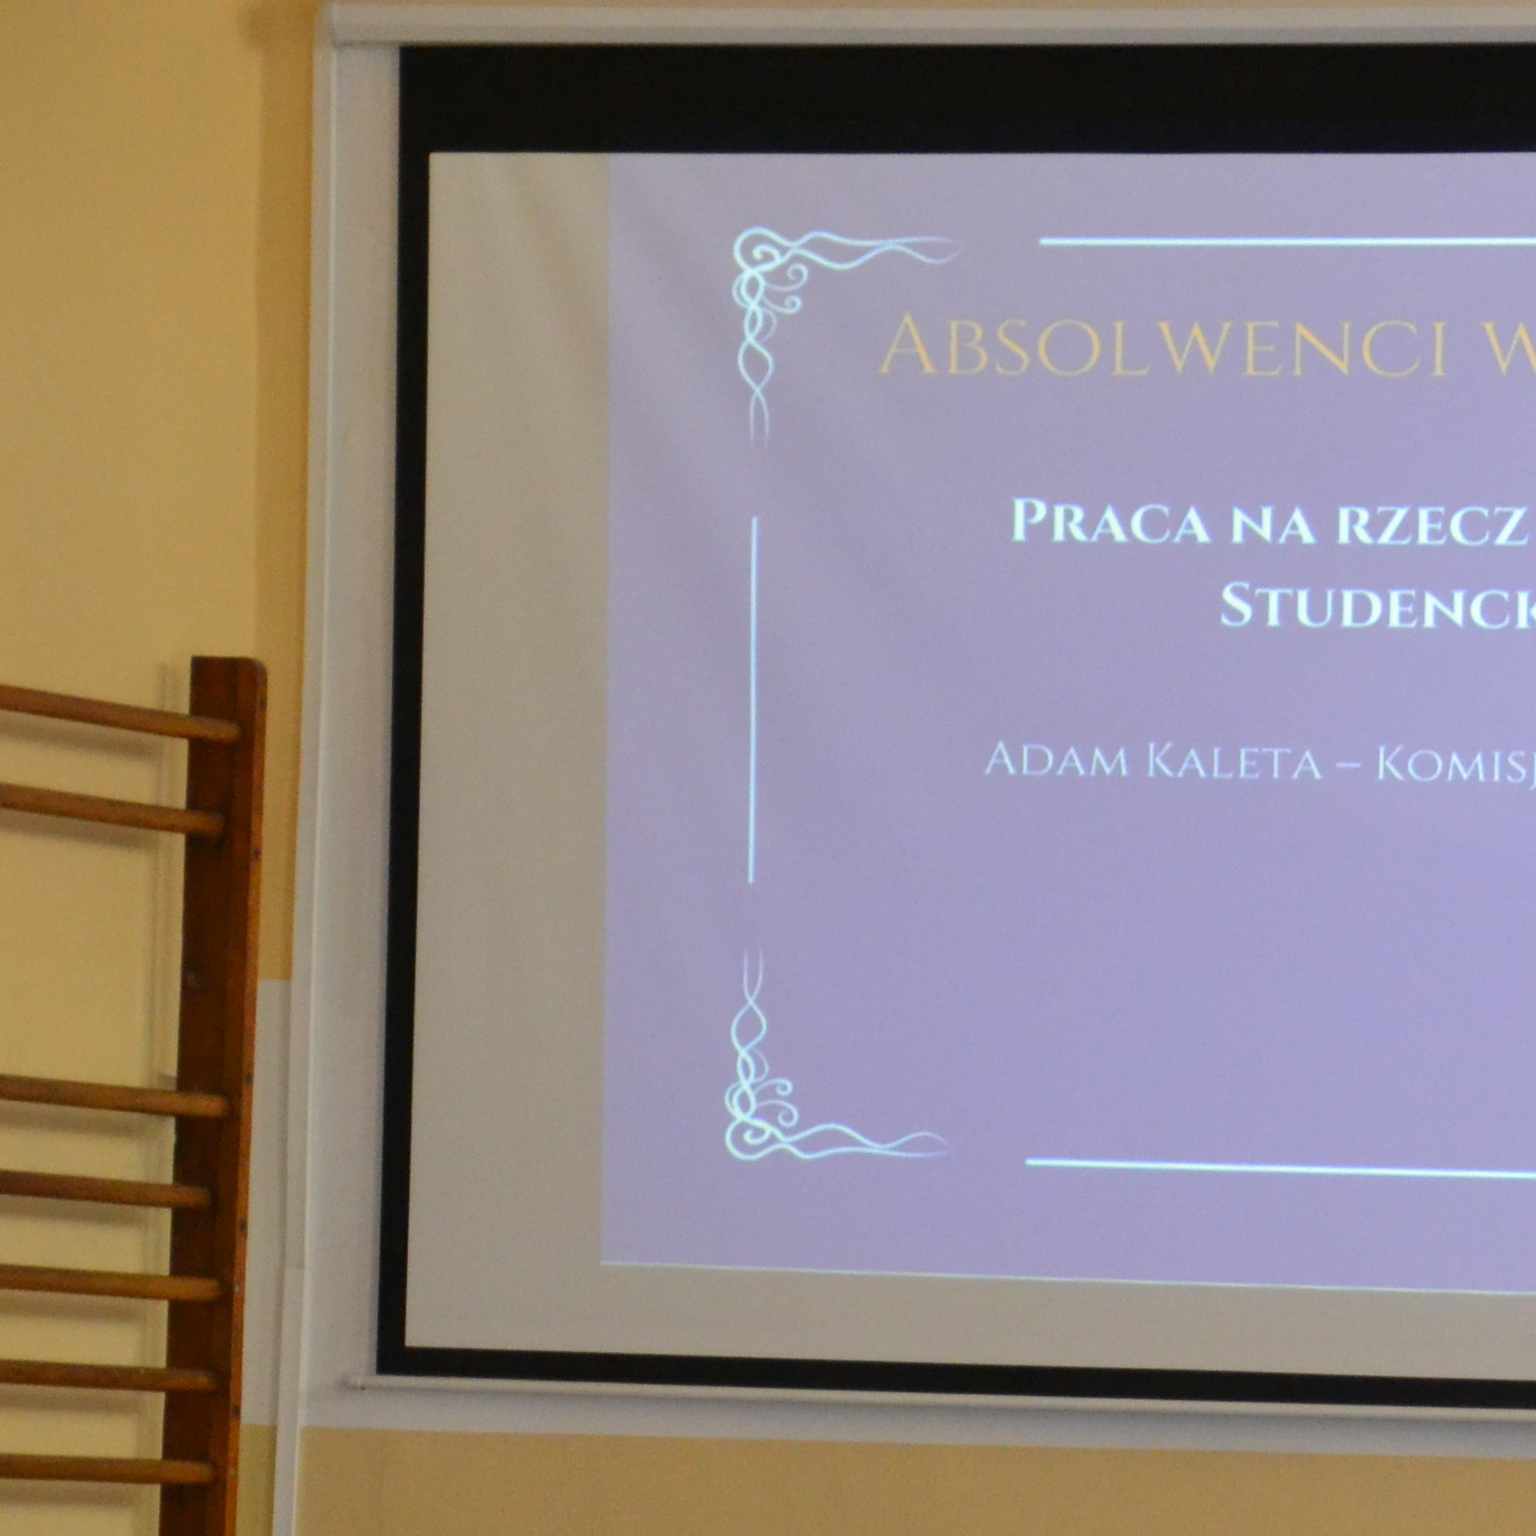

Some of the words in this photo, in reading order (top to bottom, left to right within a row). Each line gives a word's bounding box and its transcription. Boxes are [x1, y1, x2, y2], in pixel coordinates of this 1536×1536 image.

[879, 311, 1447, 378] ABSOLWENCI
[1011, 496, 1211, 545] PRACA
[1230, 505, 1318, 546] NA
[1337, 505, 1530, 547] RZECZ
[984, 739, 1130, 777] ADAM
[1146, 741, 1325, 781] KALETA
